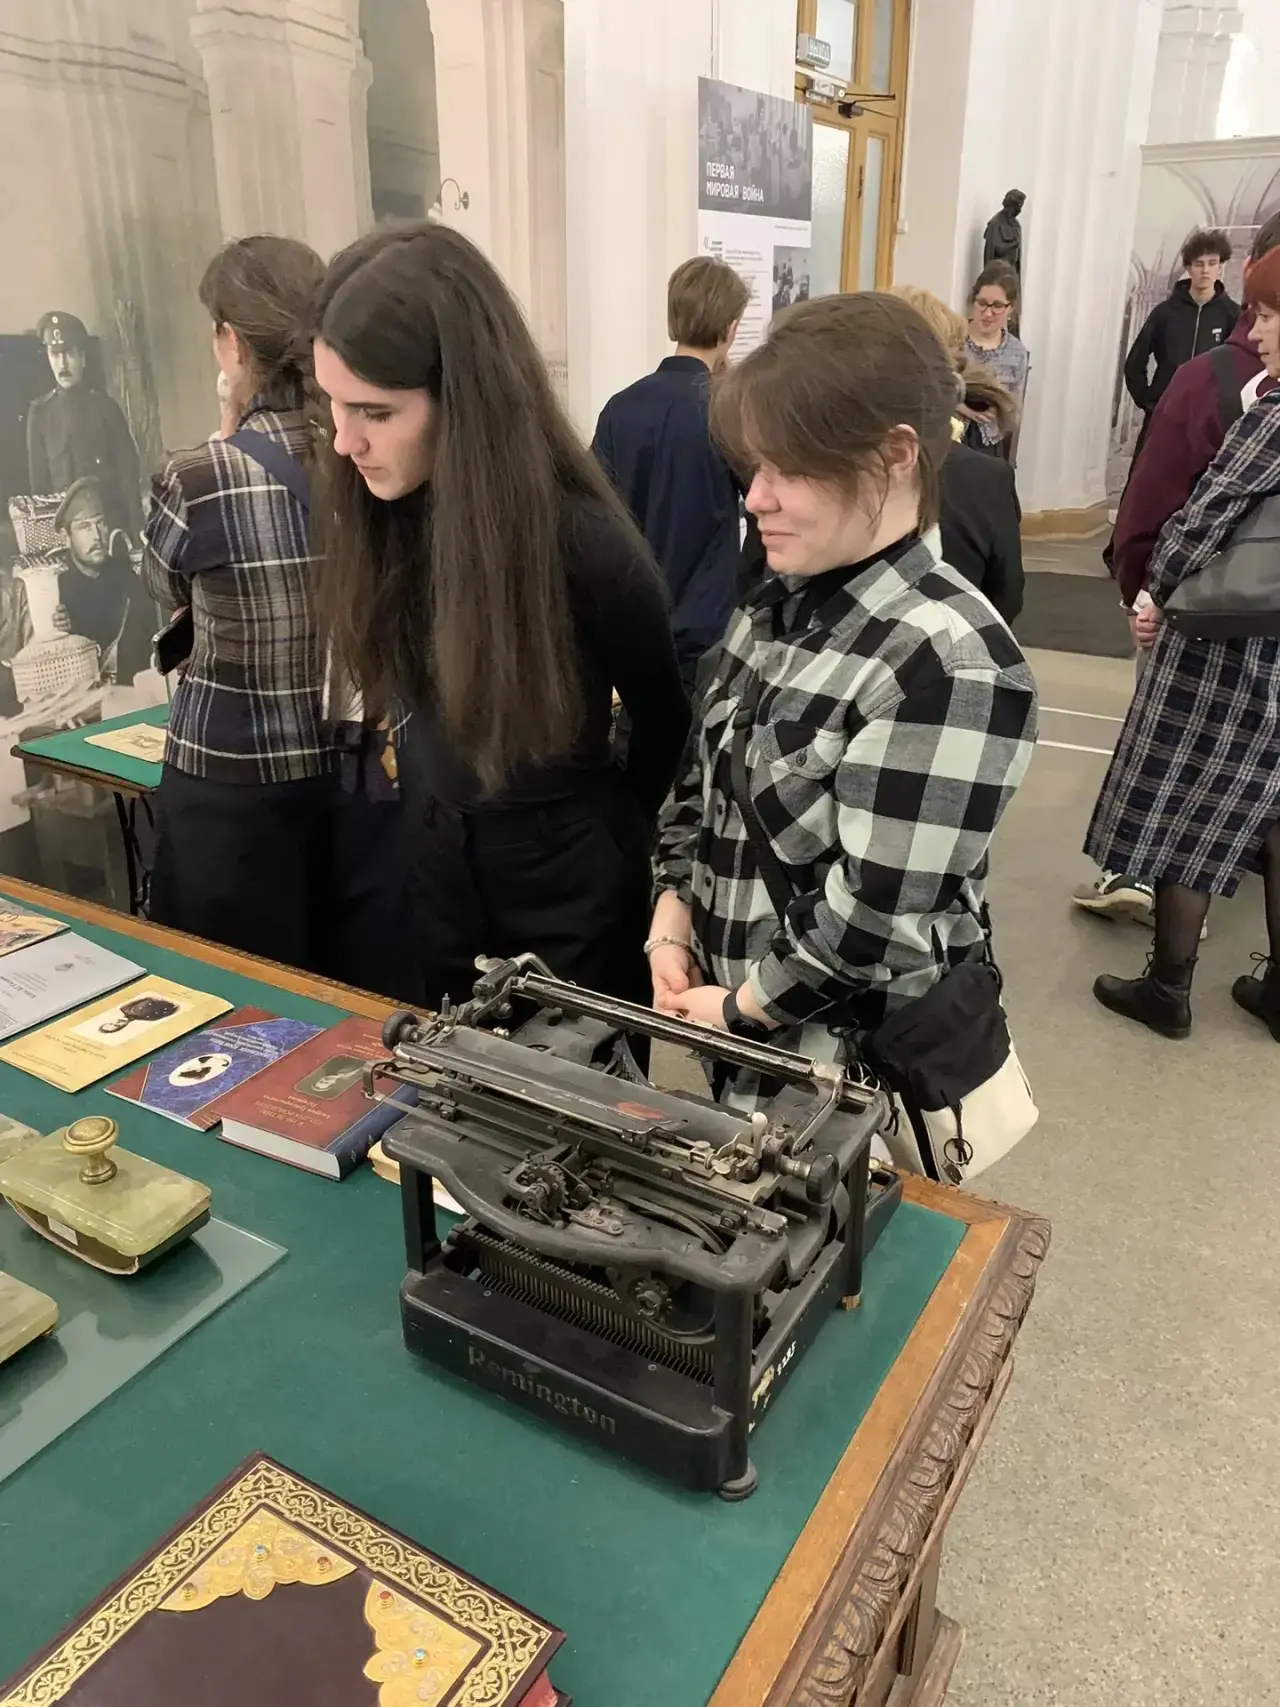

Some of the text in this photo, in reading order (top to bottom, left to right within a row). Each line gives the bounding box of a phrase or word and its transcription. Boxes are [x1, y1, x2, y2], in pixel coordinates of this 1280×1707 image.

[706, 161, 735, 180] ПЕРВАЯ
[706, 181, 765, 202] МИРОВАЯ ВОЙНА
[468, 1346, 617, 1435] Remington
